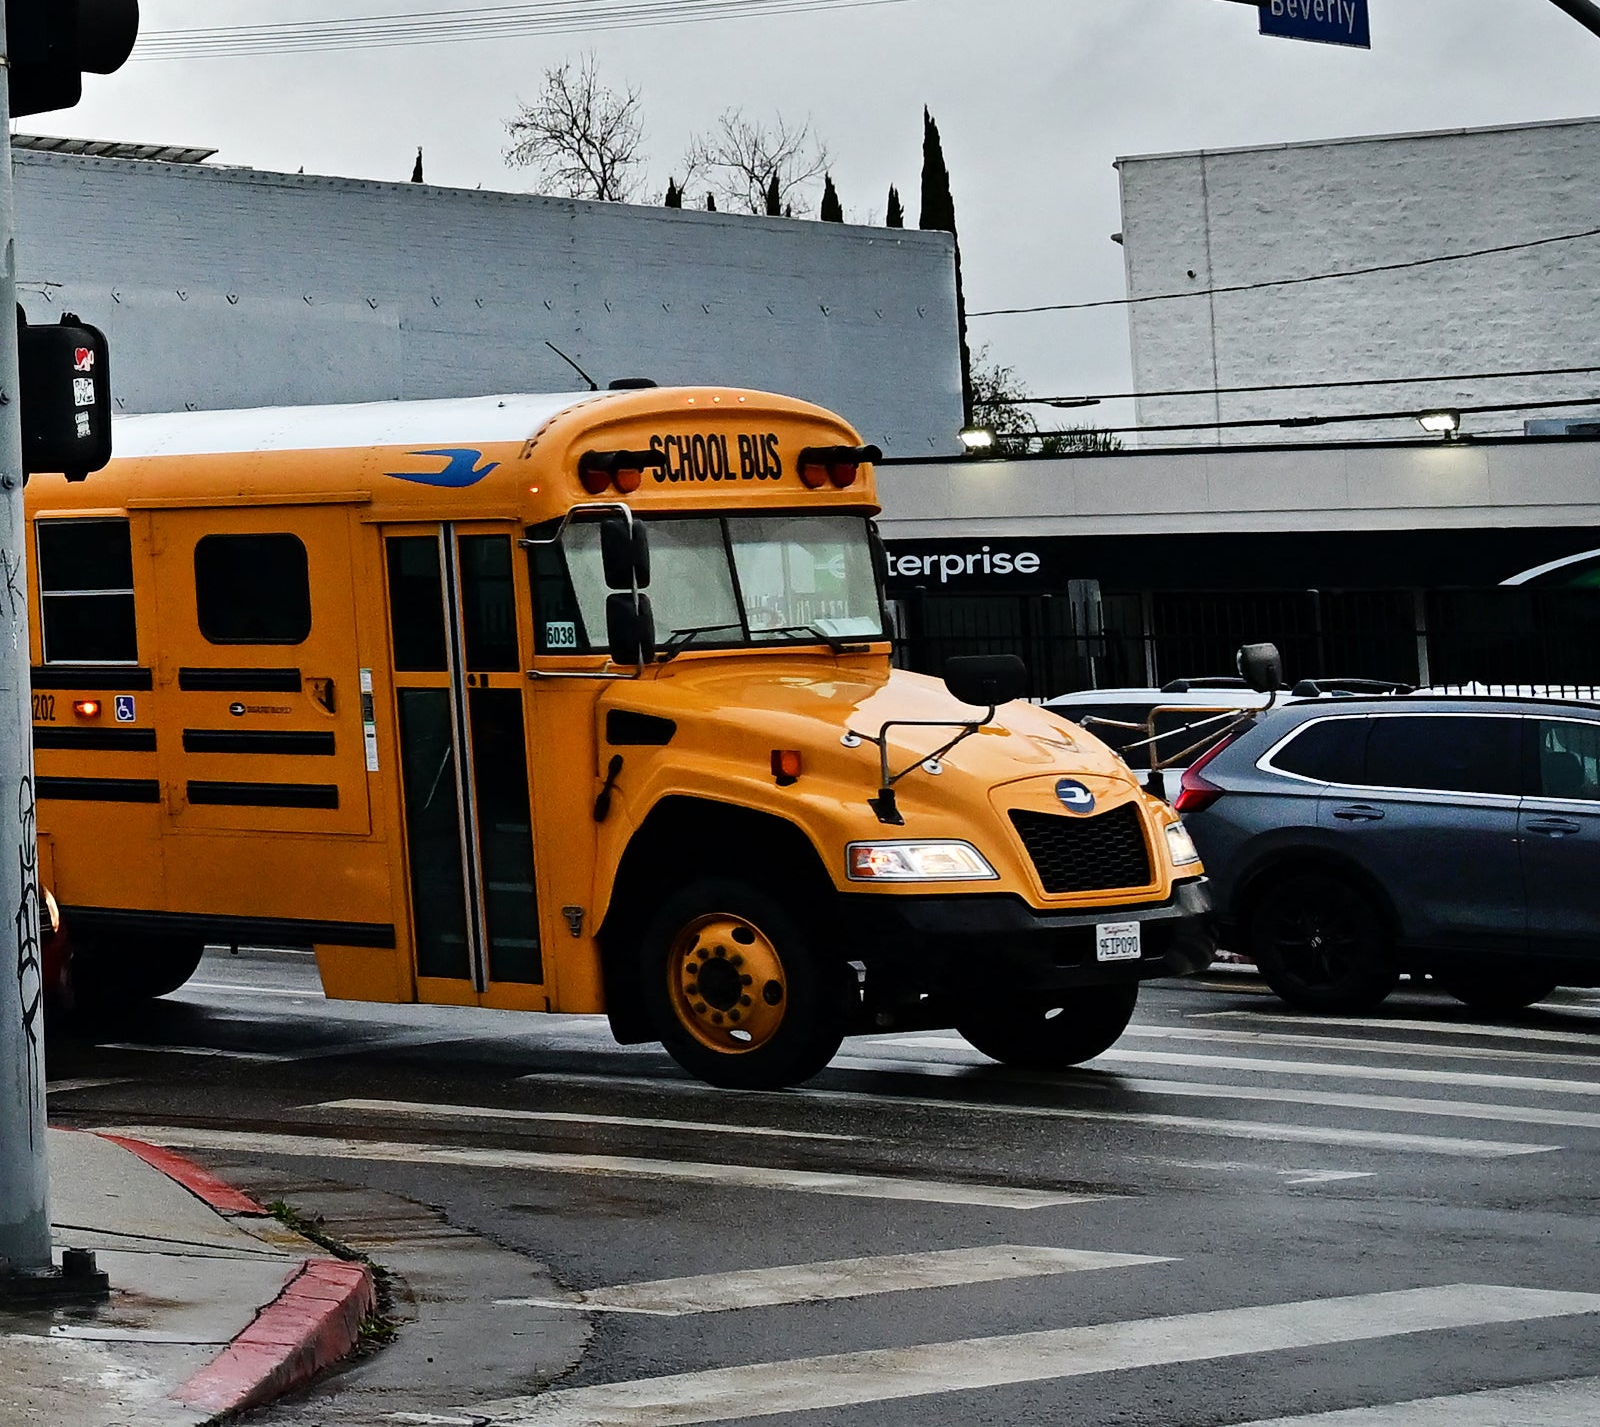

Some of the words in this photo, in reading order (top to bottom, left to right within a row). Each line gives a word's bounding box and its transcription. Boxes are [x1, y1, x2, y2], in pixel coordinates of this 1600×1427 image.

[649, 433, 737, 483] SCHOOL
[738, 432, 783, 481] BUS
[886, 545, 1040, 584] terprise
[547, 626, 574, 645] 6038
